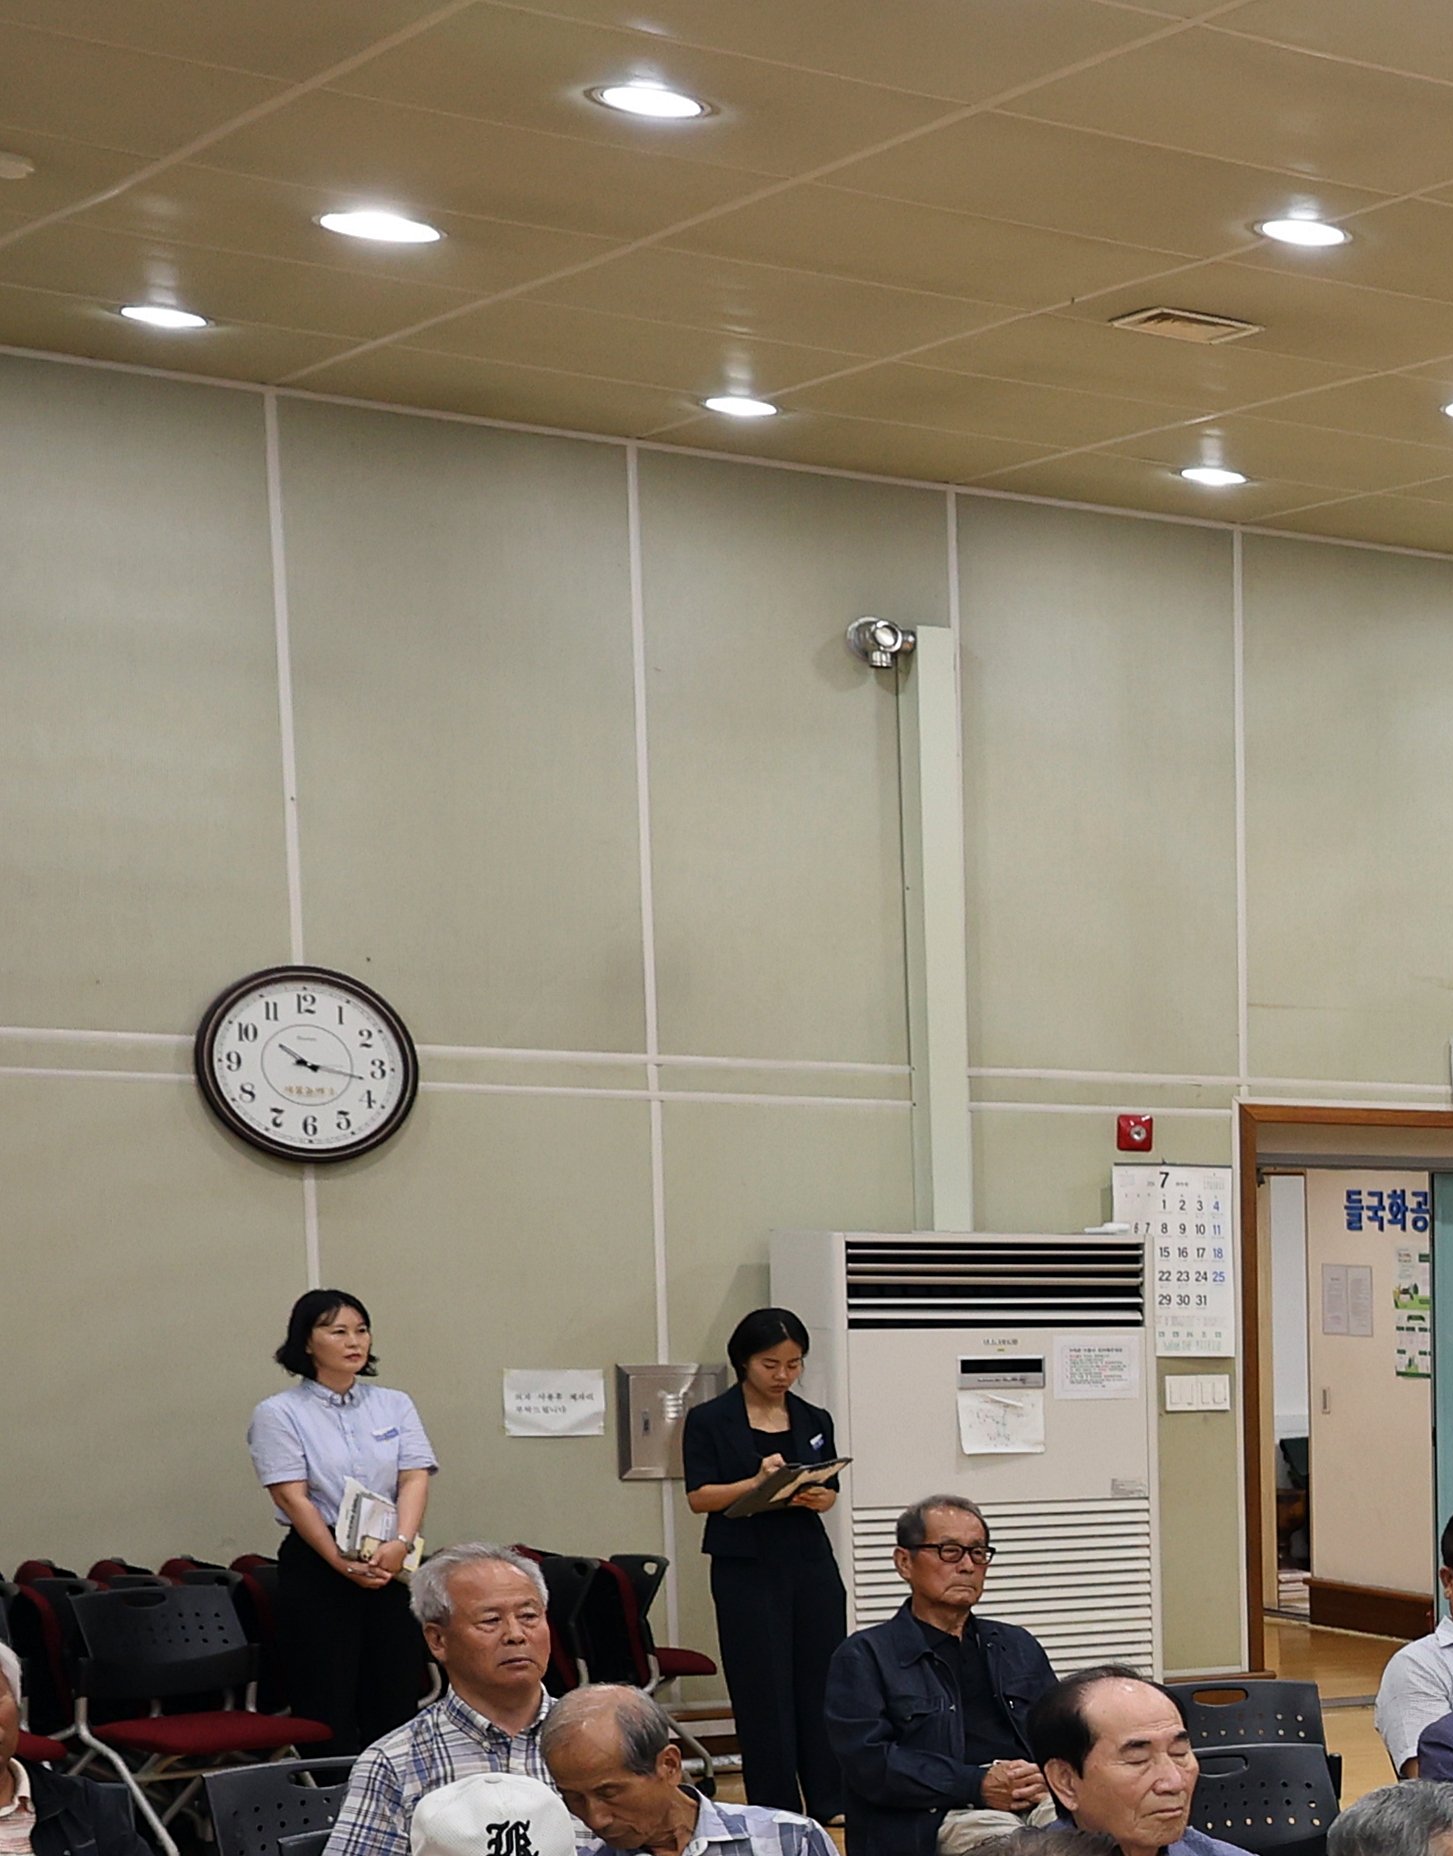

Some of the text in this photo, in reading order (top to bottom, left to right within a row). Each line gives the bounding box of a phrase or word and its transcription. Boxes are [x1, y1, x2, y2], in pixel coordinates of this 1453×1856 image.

[264, 1001, 279, 1021] 11
[297, 993, 316, 1015] 12
[337, 1005, 344, 1025] 1
[238, 1022, 258, 1043] 10
[358, 1029, 373, 1048] 2
[226, 1051, 242, 1072] 9
[370, 1058, 386, 1080] 3
[239, 1082, 256, 1104] 8
[358, 1089, 376, 1109] 4
[270, 1107, 285, 1128] 7
[302, 1115, 318, 1136] 6
[336, 1110, 351, 1130] 5
[1159, 1171, 1169, 1188] 7
[1162, 1199, 1220, 1211] 1 2 3 4
[1145, 1222, 1151, 1233] 7
[1161, 1222, 1168, 1234] 8
[1179, 1223, 1186, 1234] 9
[1195, 1224, 1206, 1235] 10
[1213, 1224, 1221, 1235] 11
[1159, 1247, 1223, 1259] 15 16 17 18
[1158, 1270, 1225, 1282] 22 23 24 25
[1158, 1294, 1207, 1306] 29 30 31
